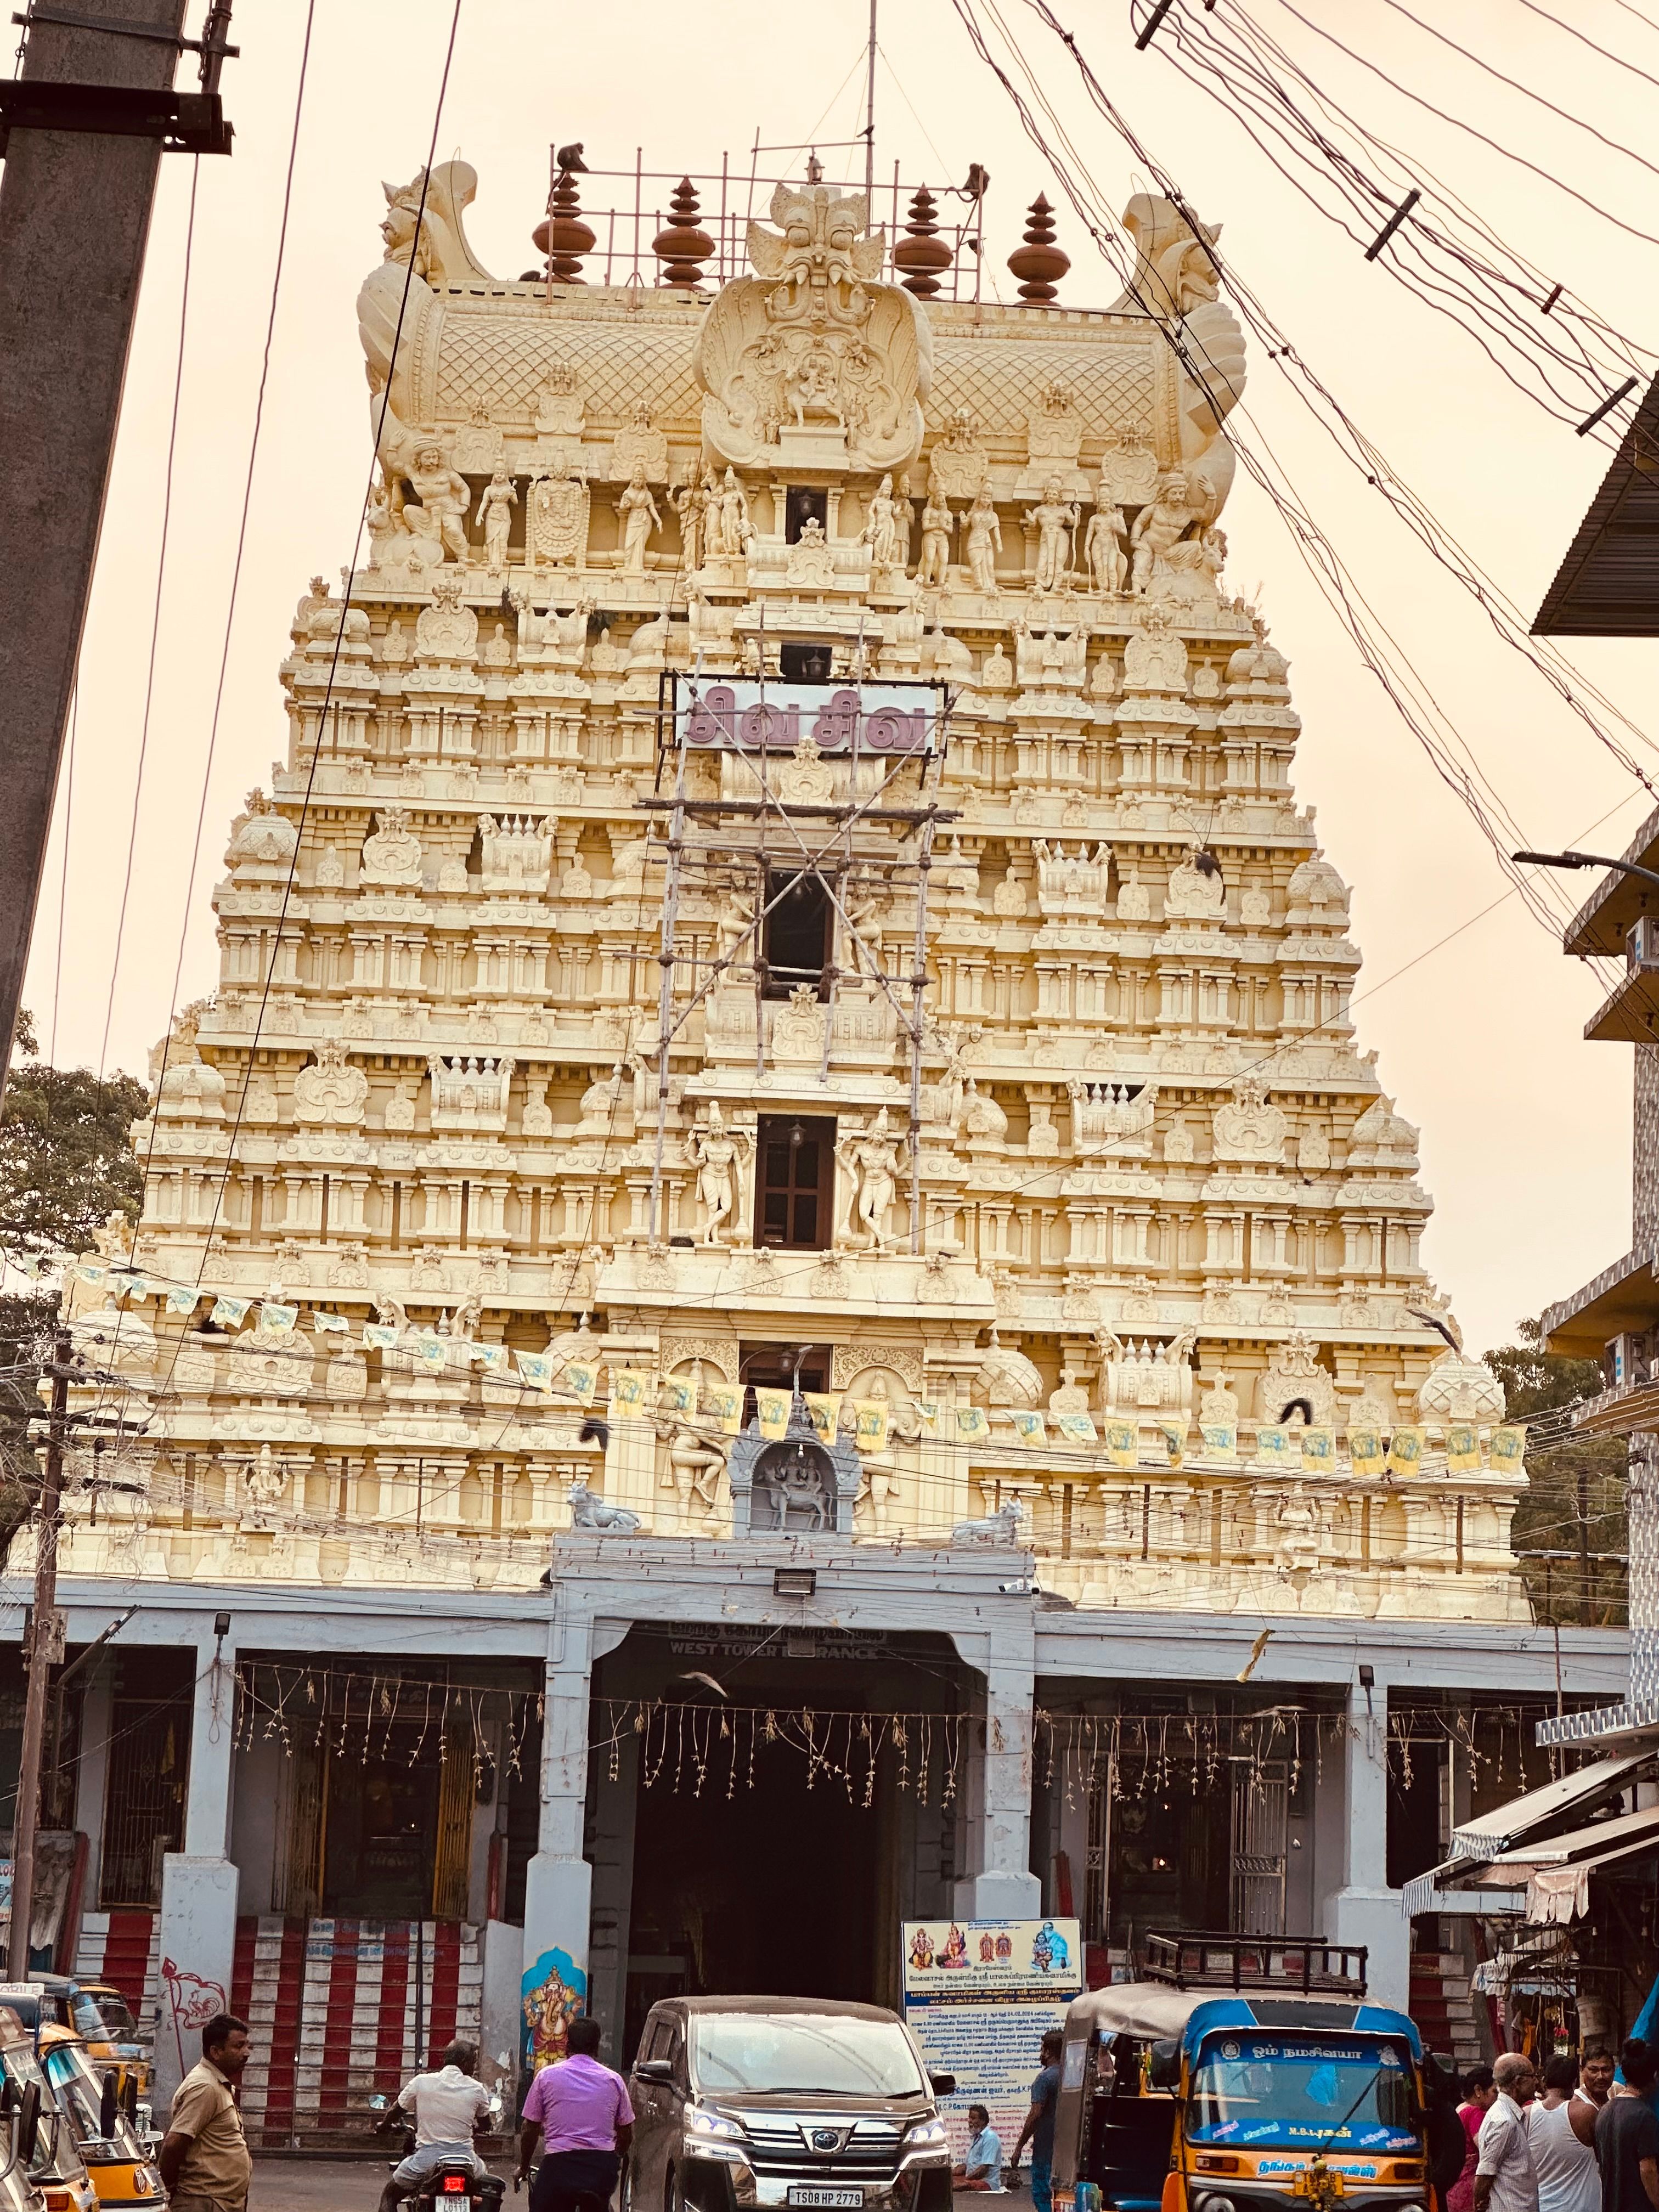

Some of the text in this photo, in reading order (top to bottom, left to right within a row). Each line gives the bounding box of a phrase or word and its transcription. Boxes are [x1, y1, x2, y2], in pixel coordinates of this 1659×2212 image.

[670, 1640, 878, 1660] WEST TOWER ERANCE
[797, 2192, 860, 2205] TS08 HP 2779
